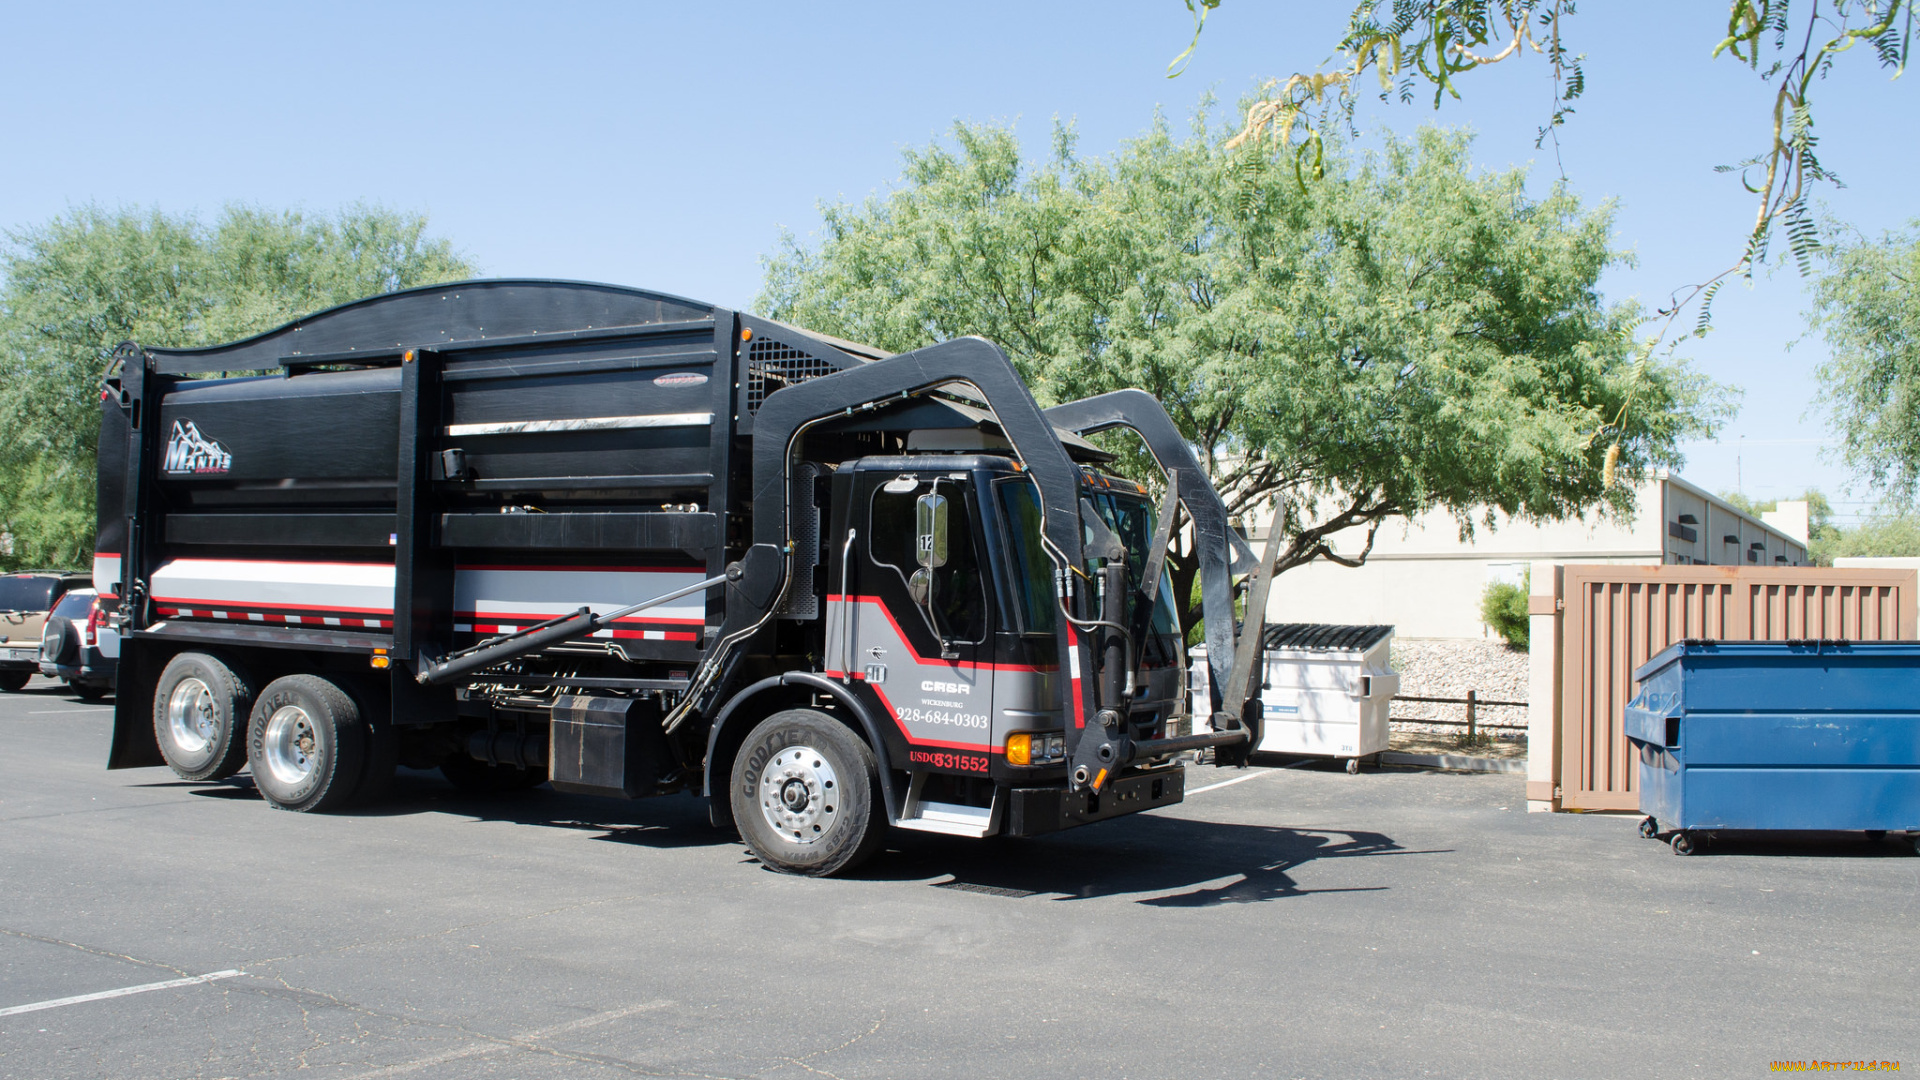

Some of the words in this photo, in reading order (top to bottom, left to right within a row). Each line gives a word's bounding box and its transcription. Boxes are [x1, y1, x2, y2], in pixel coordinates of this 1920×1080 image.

[163, 441, 232, 470] MANTIS
[921, 698, 964, 709] WICKENBURG
[254, 692, 299, 761] GOODYEAR
[896, 707, 988, 729] 928-684-0303
[743, 729, 828, 798] GOODYEAR
[935, 753, 989, 772] 531552
